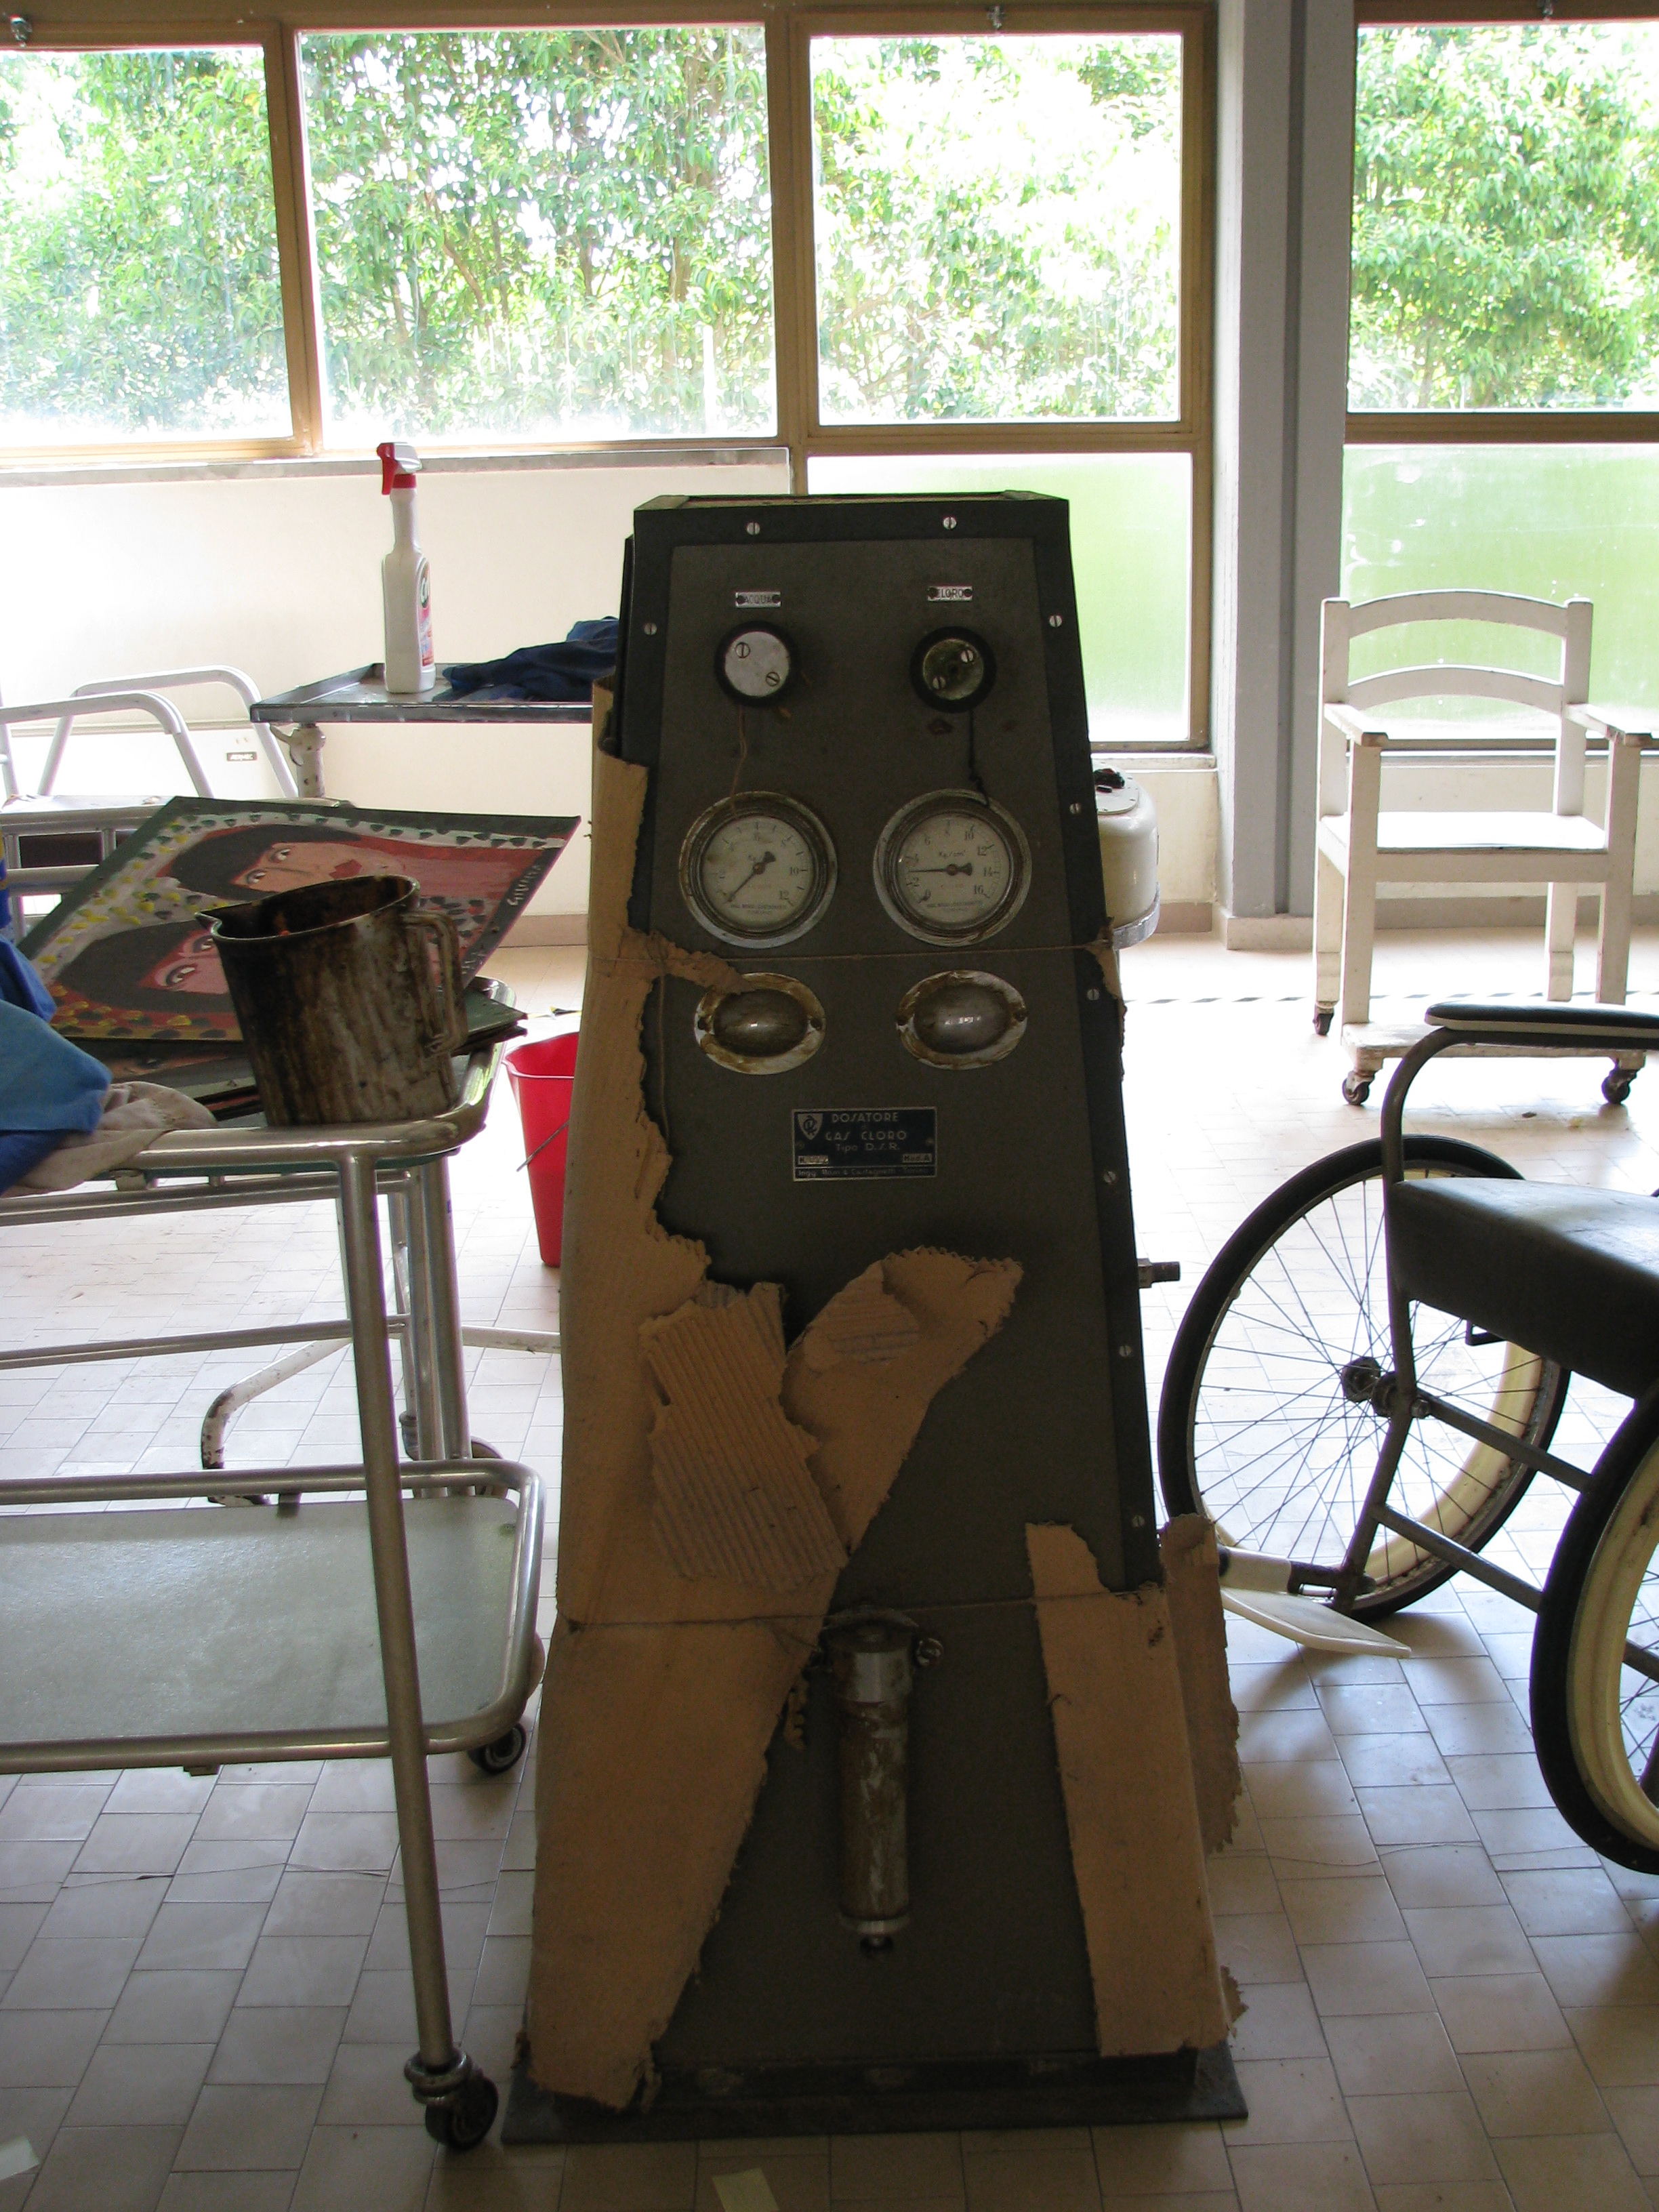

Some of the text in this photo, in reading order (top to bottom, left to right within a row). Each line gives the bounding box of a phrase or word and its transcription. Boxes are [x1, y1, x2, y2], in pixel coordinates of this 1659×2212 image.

[745, 594, 772, 604] ACQUA
[964, 830, 975, 840] 10
[977, 846, 987, 856] 12
[912, 877, 920, 886] 2
[779, 890, 790, 900] 12
[832, 1113, 899, 1122] DOSATORE
[825, 1130, 907, 1141] GAS CLORO
[836, 1144, 858, 1153] Tipo
